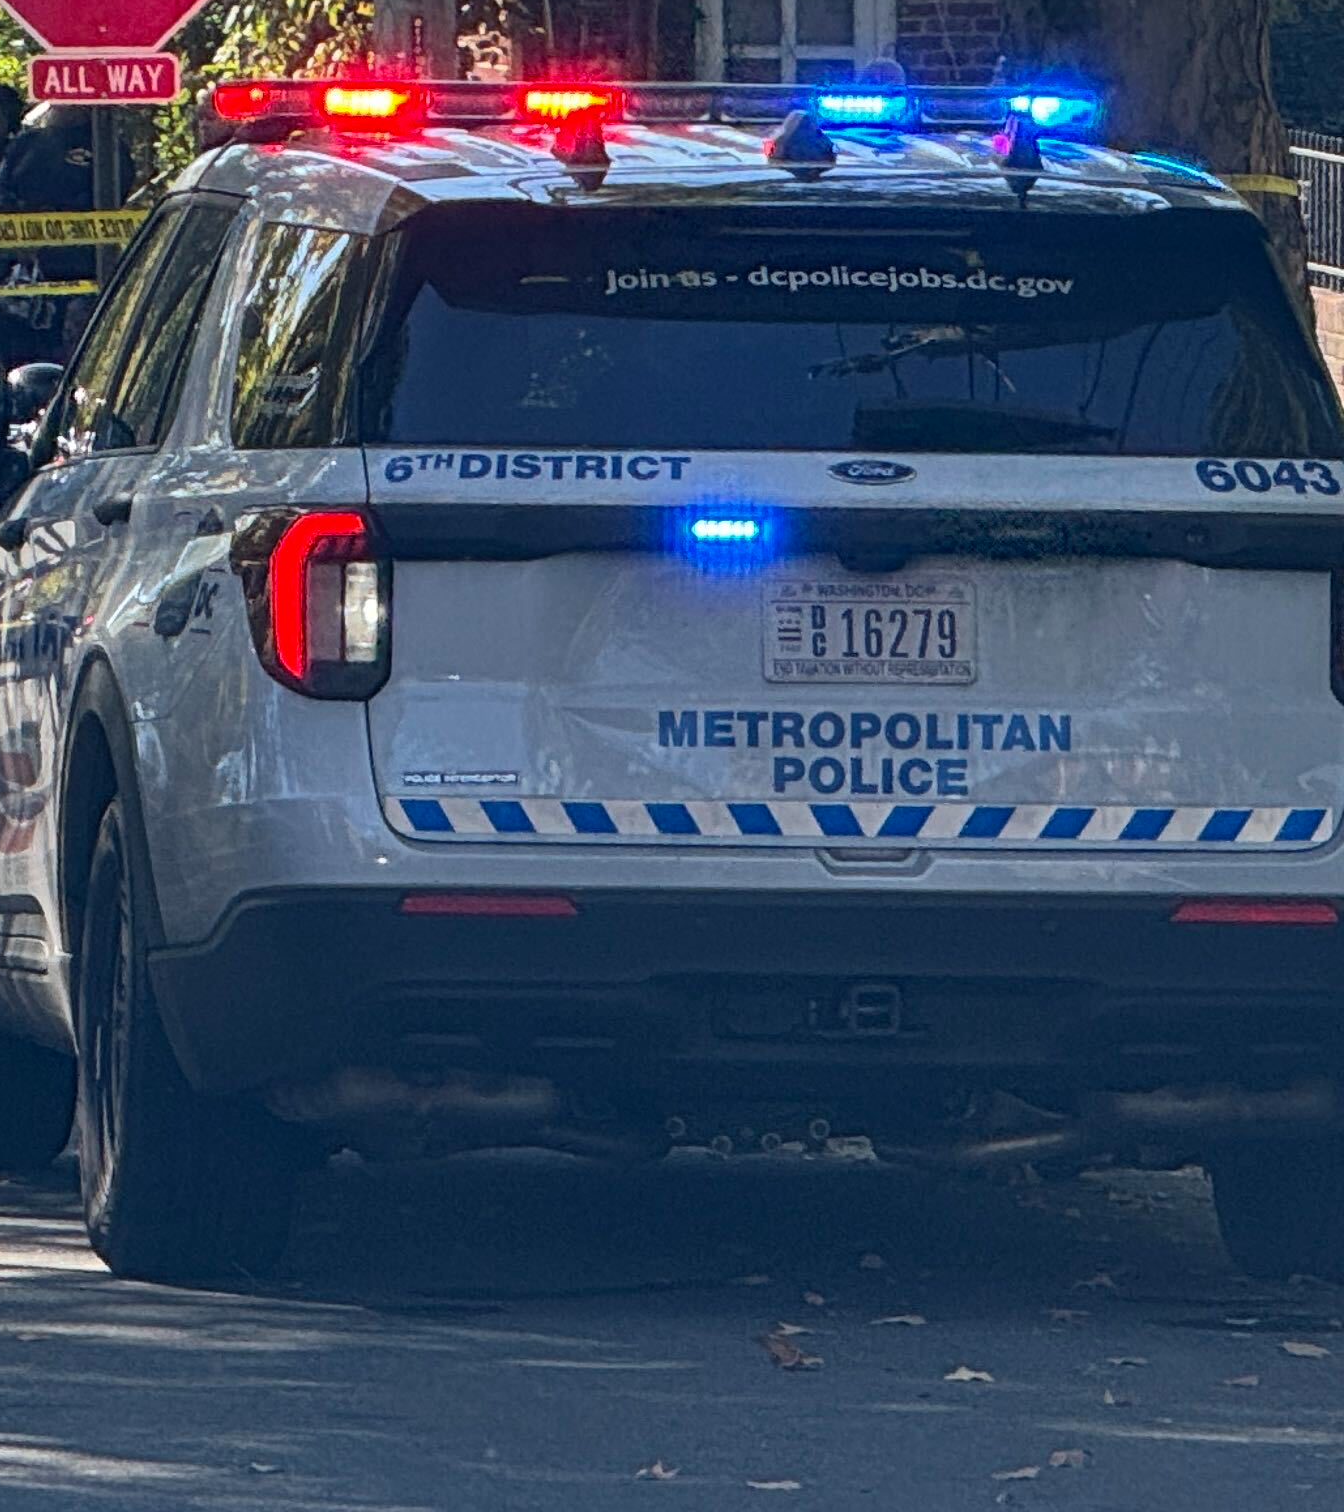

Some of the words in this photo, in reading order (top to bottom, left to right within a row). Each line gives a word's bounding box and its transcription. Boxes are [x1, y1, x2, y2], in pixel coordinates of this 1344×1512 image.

[44, 65, 93, 95] ALL
[107, 63, 164, 93] WAY
[45, 219, 64, 241] DO
[100, 218, 135, 239] OLICE
[605, 268, 669, 294] Join
[748, 266, 1073, 298] dcpolicejobs.dc.gov
[384, 453, 454, 483] 6TH
[459, 454, 691, 481] DISTRICT
[1196, 458, 1340, 495] 6043
[812, 605, 826, 630] D
[841, 608, 957, 658] 16279
[812, 631, 827, 658] C
[658, 710, 1072, 752] METROPOLITAN
[773, 756, 969, 796] POLICE
